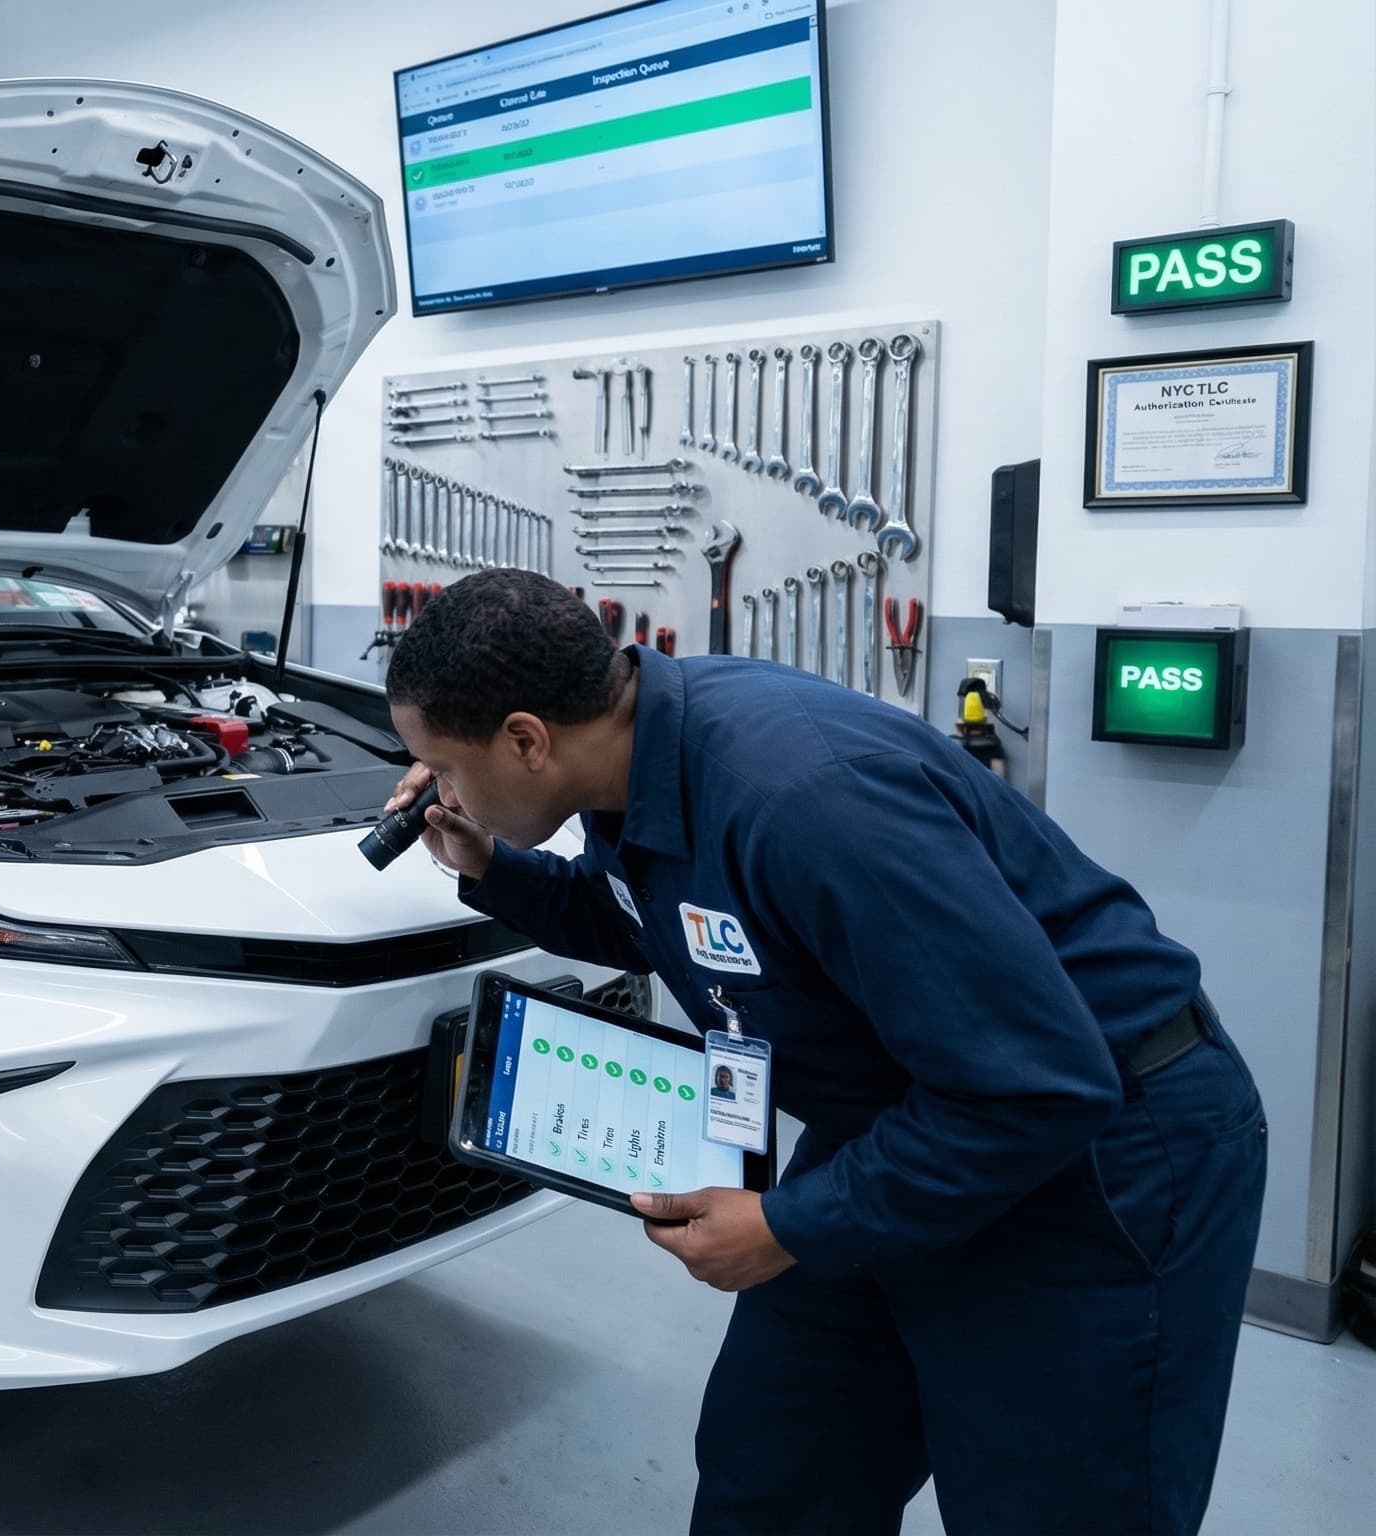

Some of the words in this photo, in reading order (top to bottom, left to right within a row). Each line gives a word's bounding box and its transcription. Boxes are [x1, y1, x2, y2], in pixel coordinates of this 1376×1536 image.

[1129, 239, 1263, 295] PASS
[1161, 384, 1194, 398] NYC
[1197, 381, 1229, 395] TLC
[1120, 665, 1203, 691] PASS
[687, 911, 745, 954] TLC
